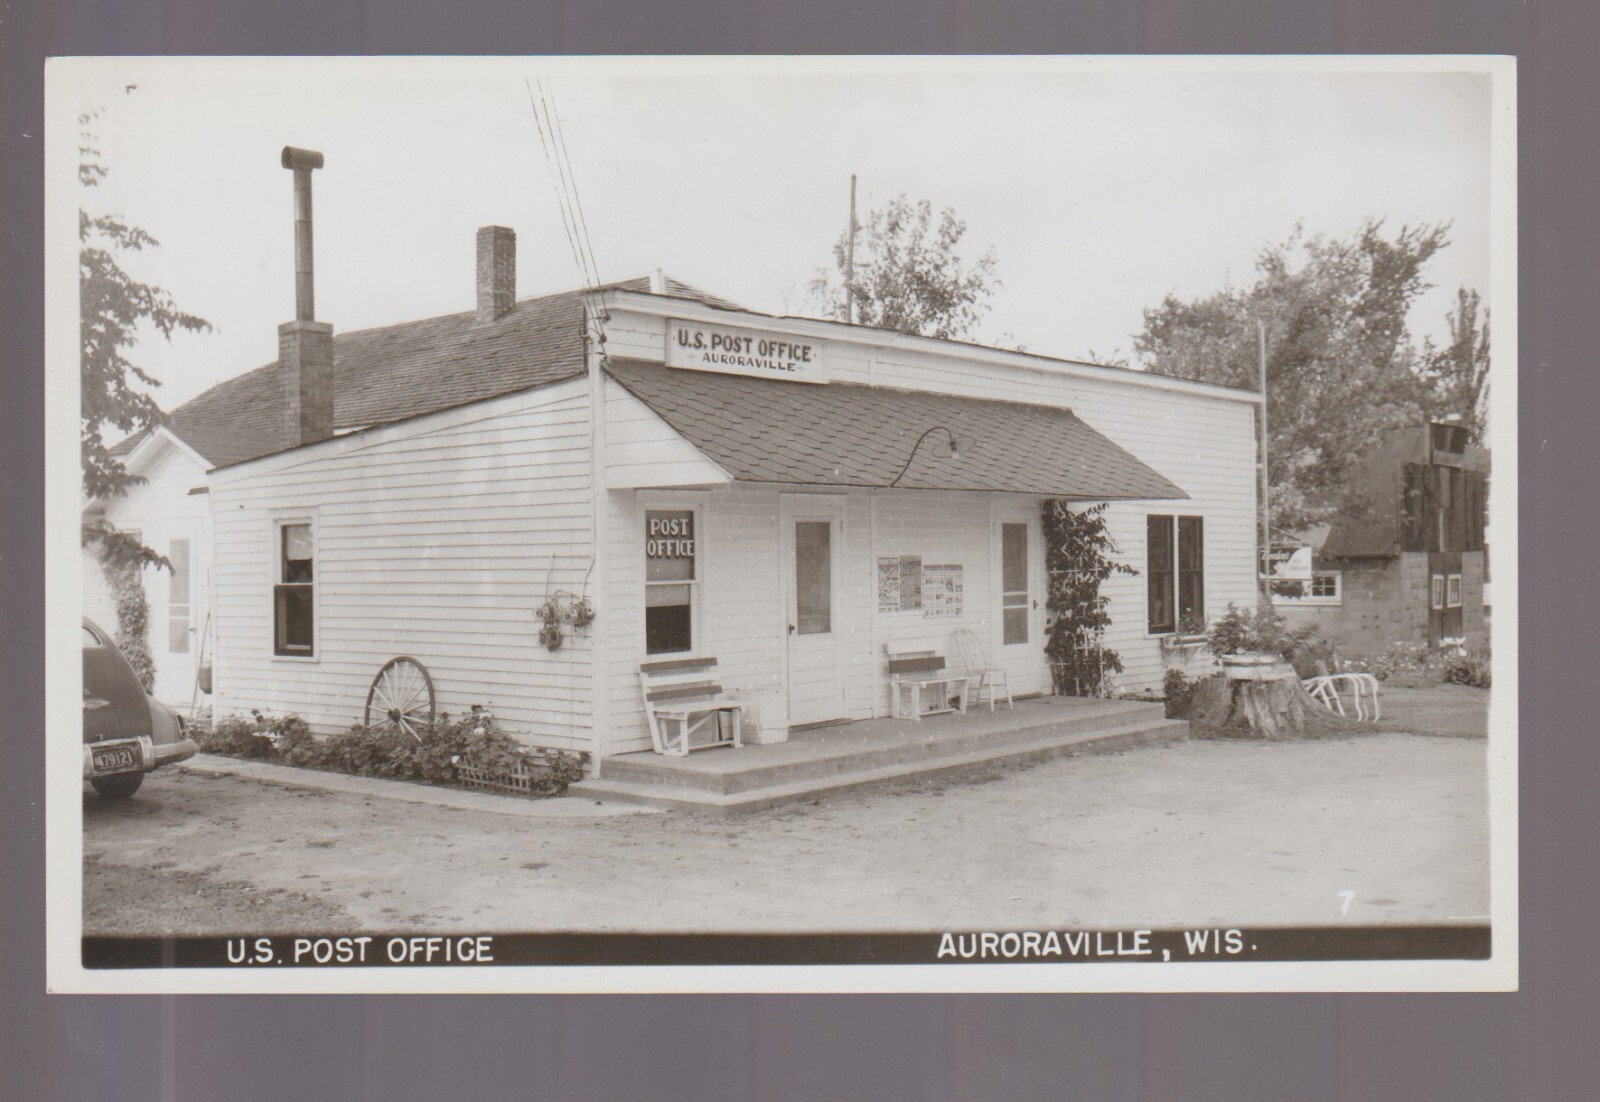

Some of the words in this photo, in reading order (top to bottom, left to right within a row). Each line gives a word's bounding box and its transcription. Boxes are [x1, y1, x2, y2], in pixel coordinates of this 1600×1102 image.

[678, 329, 707, 349] U.S.
[711, 334, 752, 354] POST
[758, 340, 811, 362] OFFICE
[702, 352, 796, 371] AURORAVILLE
[650, 519, 688, 536] POST
[647, 540, 694, 556] OFFICE
